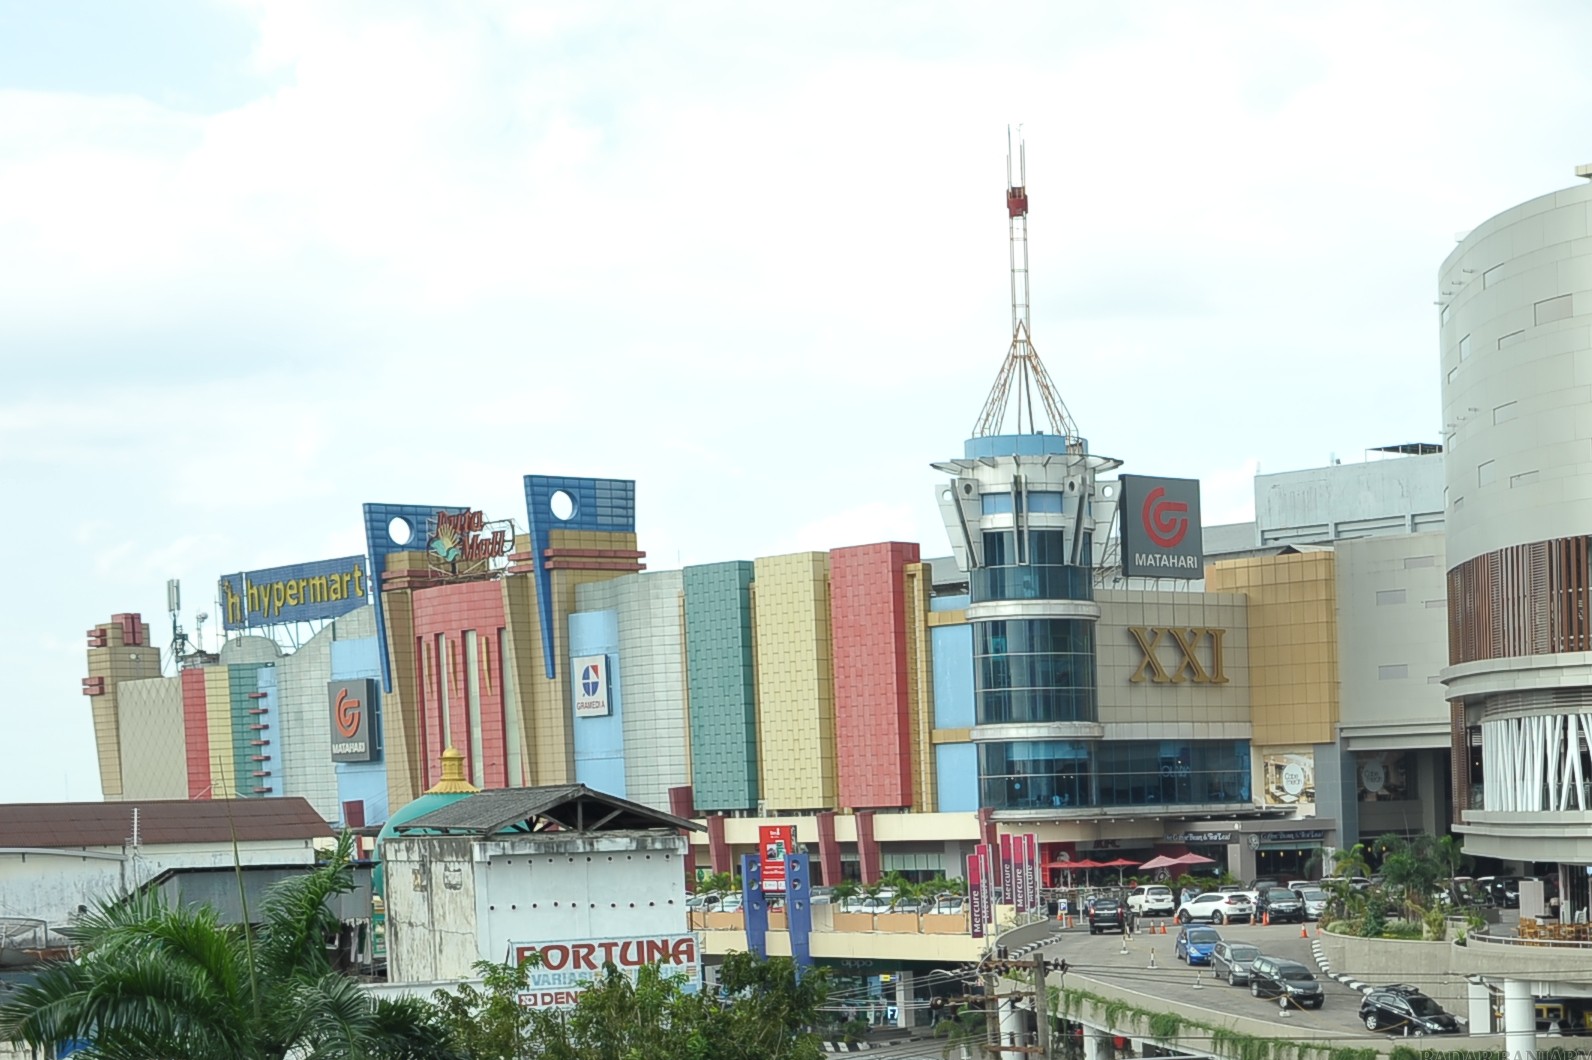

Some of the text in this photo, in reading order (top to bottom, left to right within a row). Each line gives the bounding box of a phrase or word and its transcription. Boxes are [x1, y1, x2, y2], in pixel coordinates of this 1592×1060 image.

[1135, 553, 1198, 569] MATAHARI
[246, 563, 365, 618] hypermart
[1128, 627, 1230, 684] XXI
[973, 890, 981, 933] Mercure
[516, 938, 695, 971] FORTUNA
